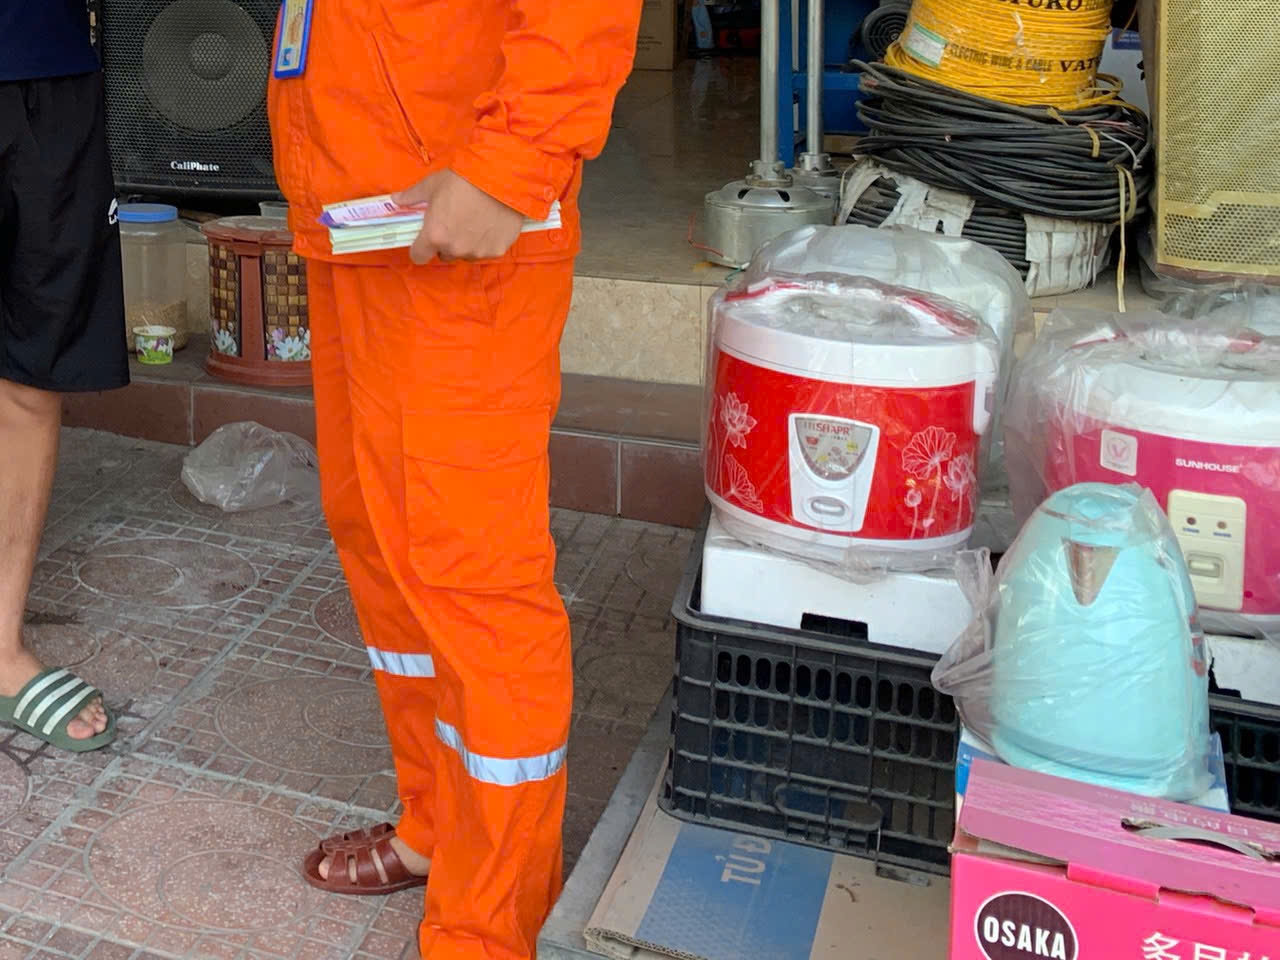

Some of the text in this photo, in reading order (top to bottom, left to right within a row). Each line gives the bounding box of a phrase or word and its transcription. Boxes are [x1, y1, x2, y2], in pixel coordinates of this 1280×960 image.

[170, 160, 220, 172] CaliPhate
[1176, 458, 1240, 473] SUNHOUSE
[983, 916, 1066, 960] OSAKA
